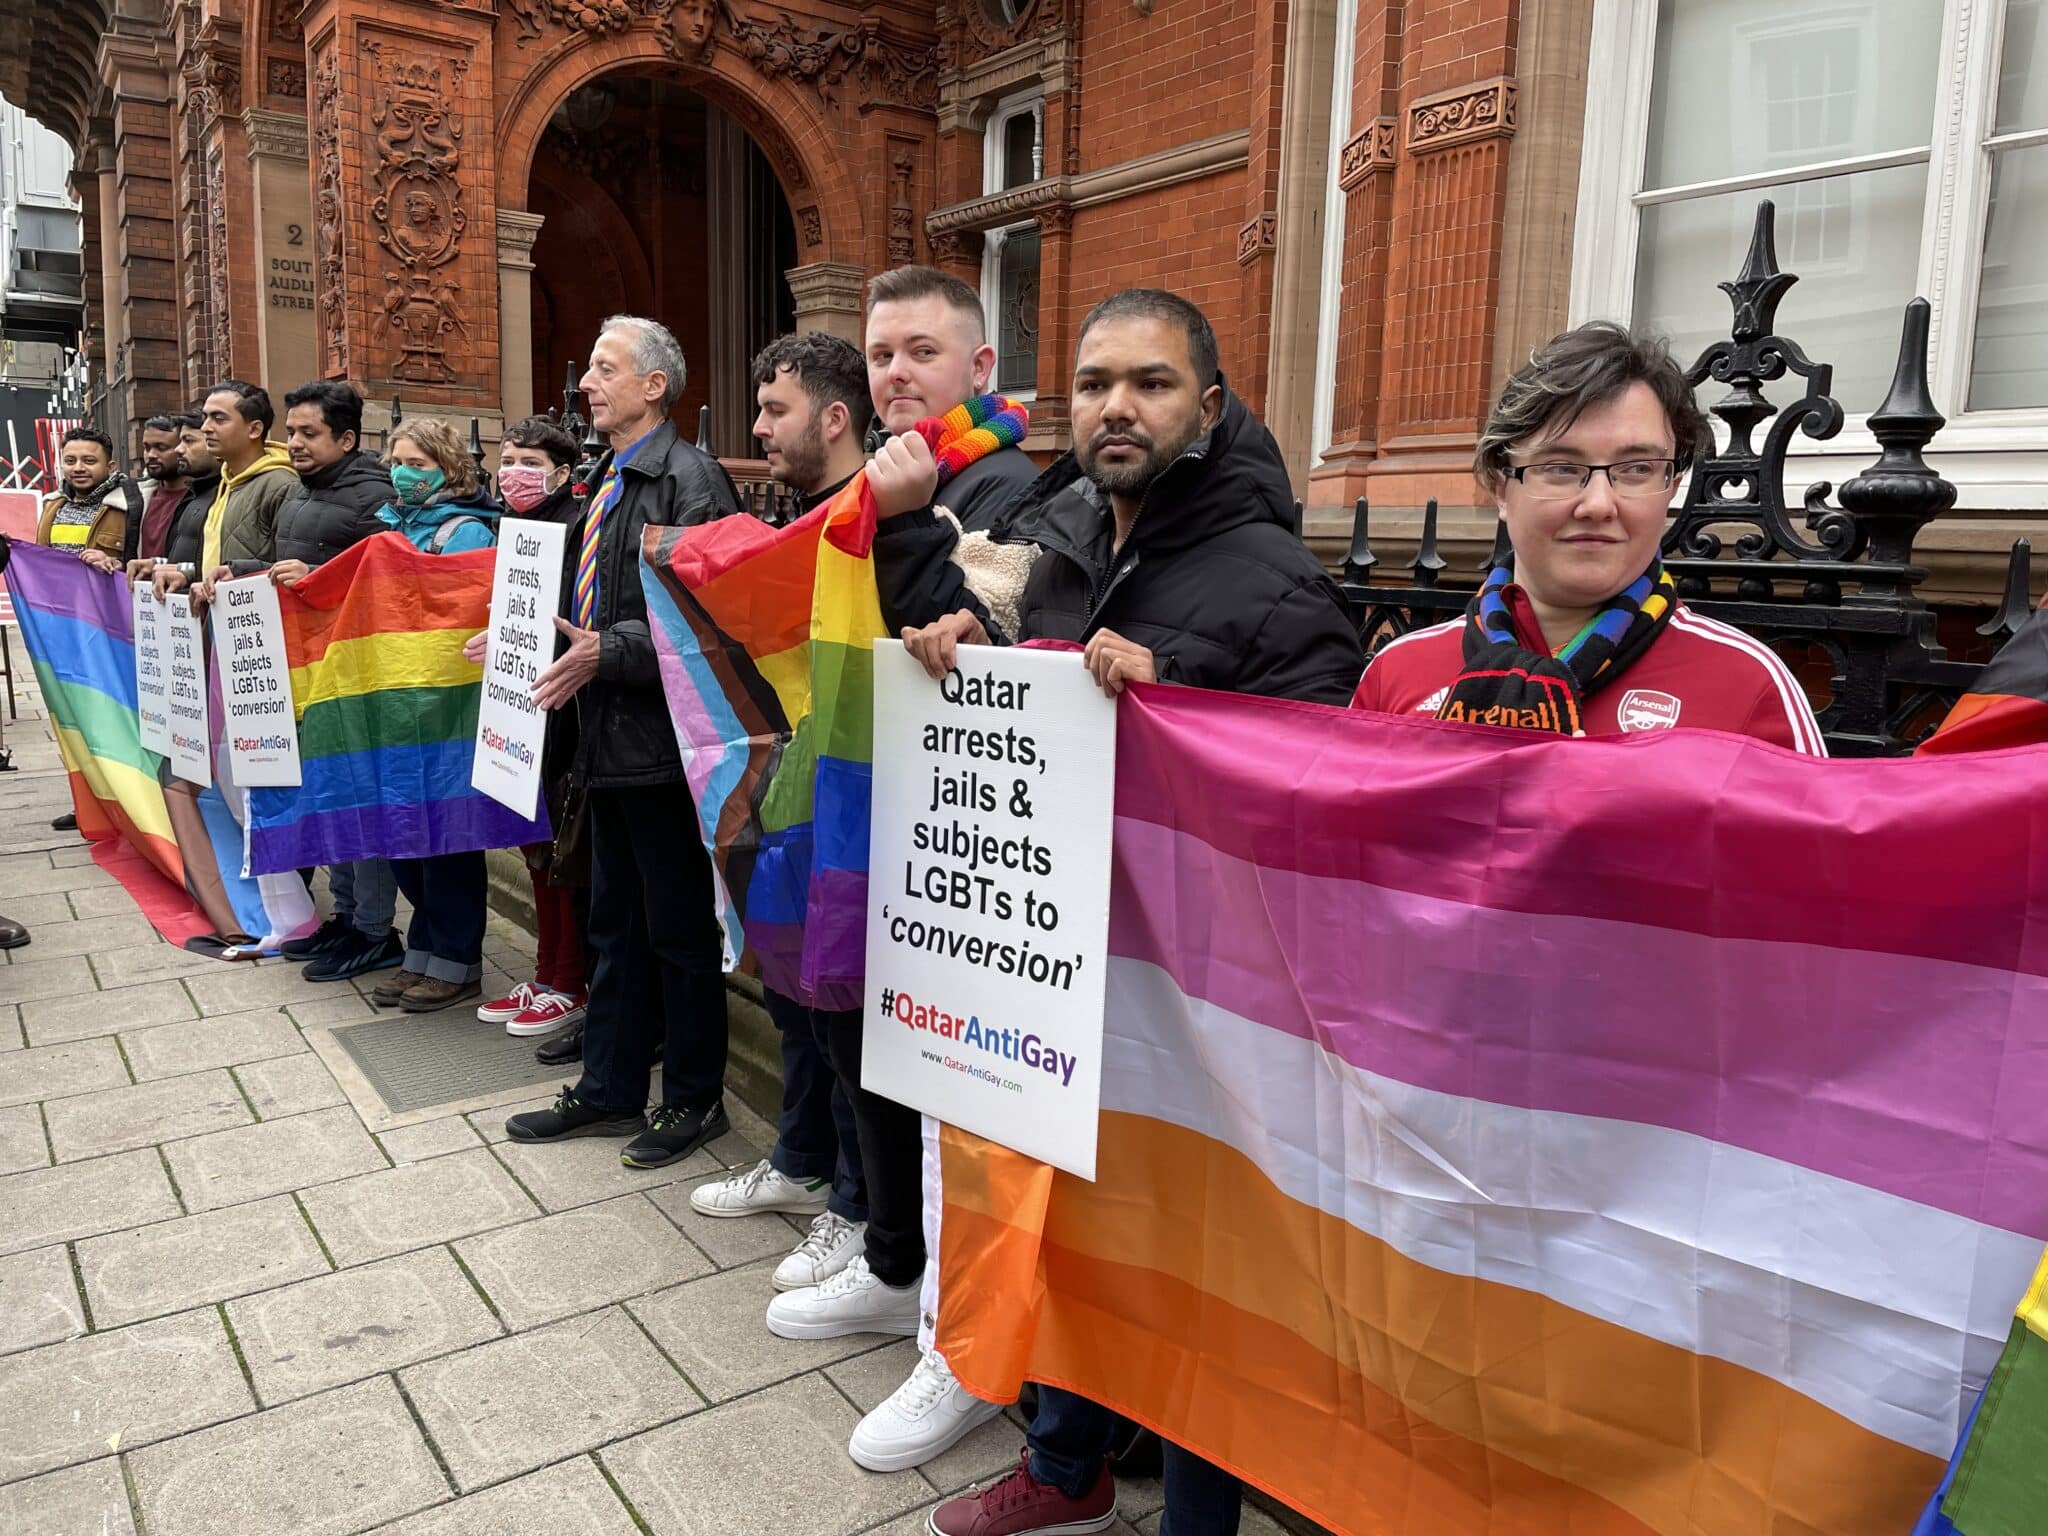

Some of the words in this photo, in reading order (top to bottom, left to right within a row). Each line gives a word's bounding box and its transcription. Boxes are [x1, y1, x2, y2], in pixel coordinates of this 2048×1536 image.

[287, 224, 303, 246] 2
[271, 258, 312, 274] SOUT
[271, 294, 315, 310] STREE
[515, 532, 541, 558] Qatar
[508, 567, 542, 594] arrests,
[172, 602, 187, 618] Qatar
[228, 589, 254, 607] Qatar
[506, 592, 527, 619] jails
[528, 596, 536, 619] &
[227, 610, 264, 630] arrests,
[233, 633, 254, 655] jails
[256, 631, 264, 648] &
[499, 622, 539, 652] subjects
[173, 642, 185, 660] jails
[187, 643, 191, 659] &
[172, 662, 196, 681] subjects
[232, 653, 272, 675] subjects
[494, 648, 525, 679] LGBTs
[527, 660, 537, 682] to
[172, 680, 191, 699] LGBTs
[192, 685, 199, 700] to
[232, 676, 265, 695] LGBTs
[267, 676, 278, 692] to
[486, 676, 537, 716] ‘conversion
[940, 666, 1031, 711] Qatar
[228, 696, 287, 717] ‘conversion’
[1629, 697, 1672, 712] Arsenal
[233, 735, 290, 752] #QatarAntiGay
[482, 726, 535, 770] #QatarAntiGay
[923, 723, 1047, 775] arrests,
[930, 766, 997, 812] jails
[1009, 779, 1034, 819] &
[913, 820, 1052, 876] subjects
[905, 861, 1013, 921] LGBTs
[1024, 889, 1059, 931] to
[883, 904, 1083, 990] ‘conversion’
[881, 987, 1077, 1087] #QatarAntiGay
[920, 1049, 1023, 1094] www.QatarAntiGay.com
